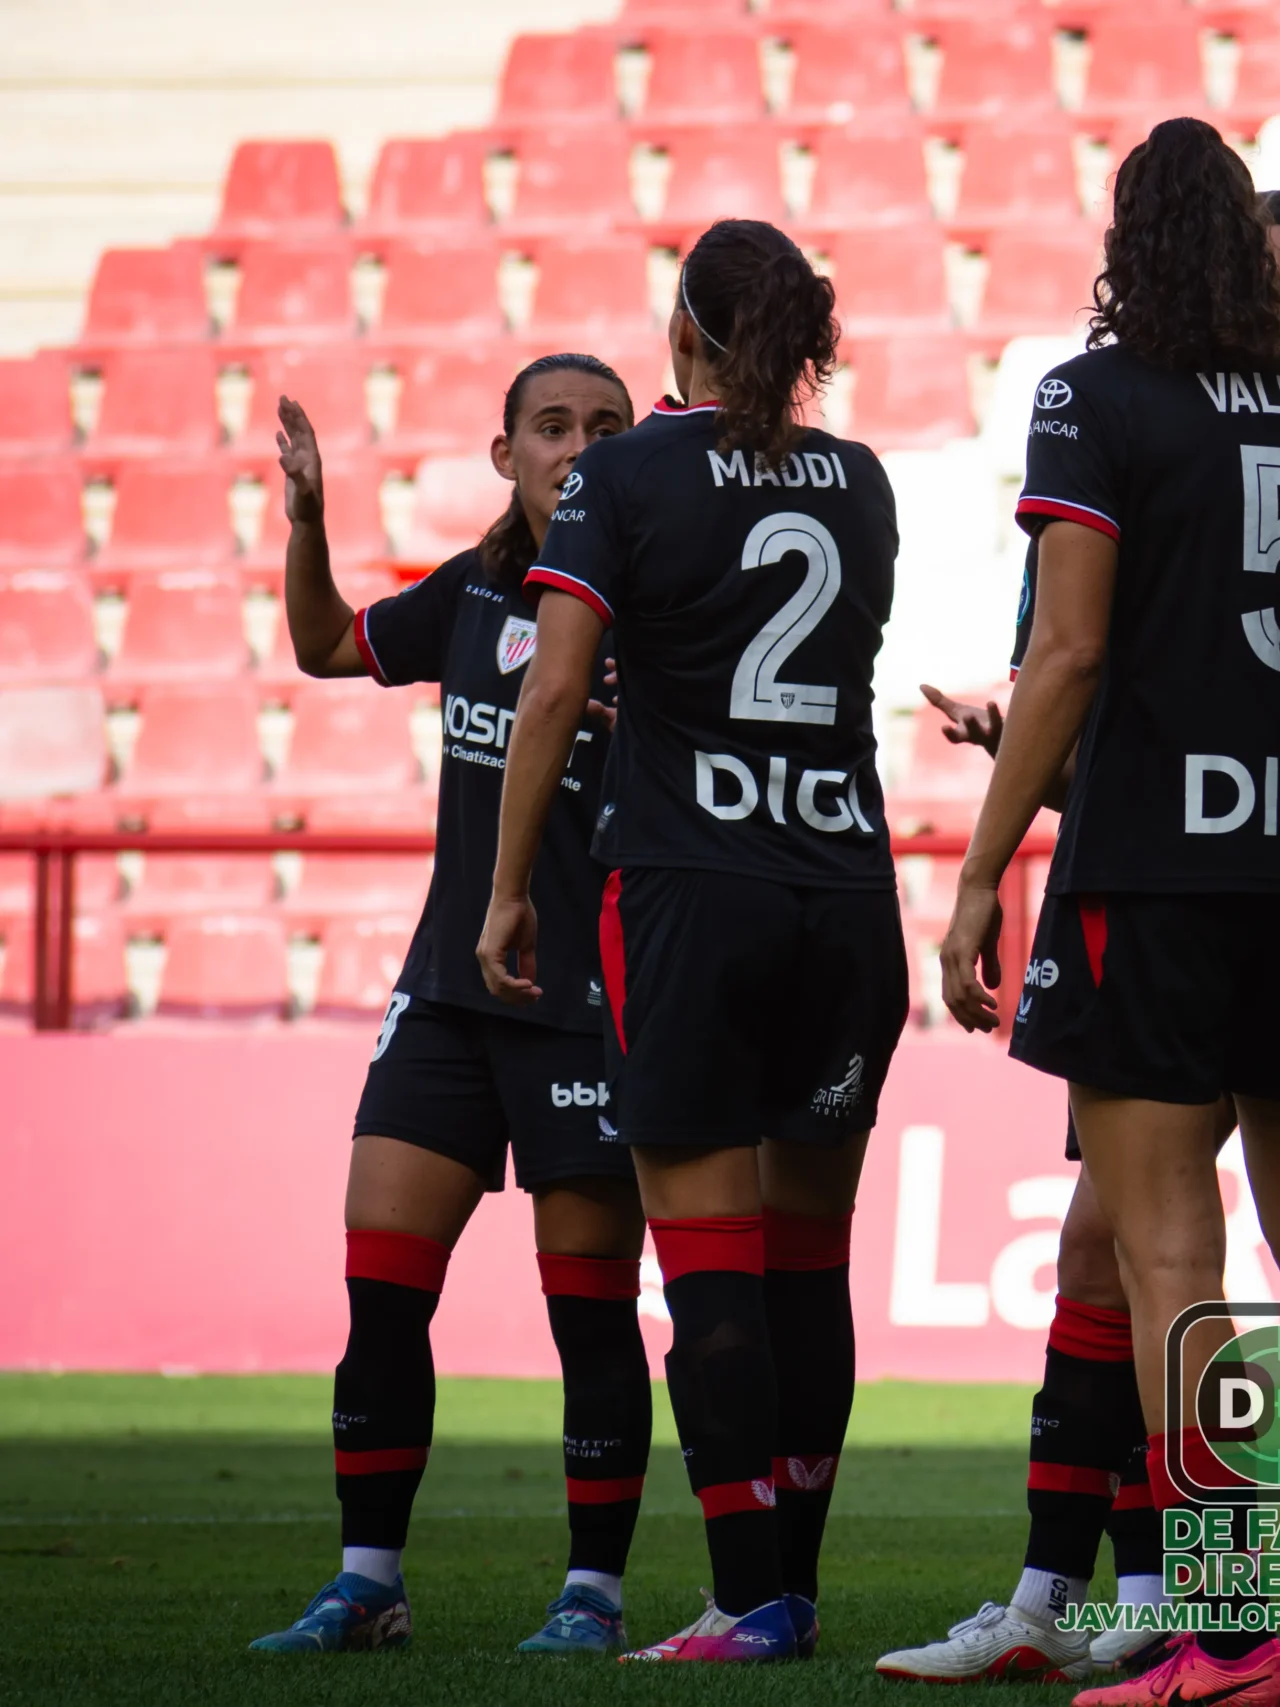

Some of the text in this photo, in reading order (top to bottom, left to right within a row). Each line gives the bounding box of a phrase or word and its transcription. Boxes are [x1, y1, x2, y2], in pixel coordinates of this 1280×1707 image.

[706, 449, 848, 489] MADDI
[729, 511, 842, 726] 2
[694, 750, 875, 833] DIGI
